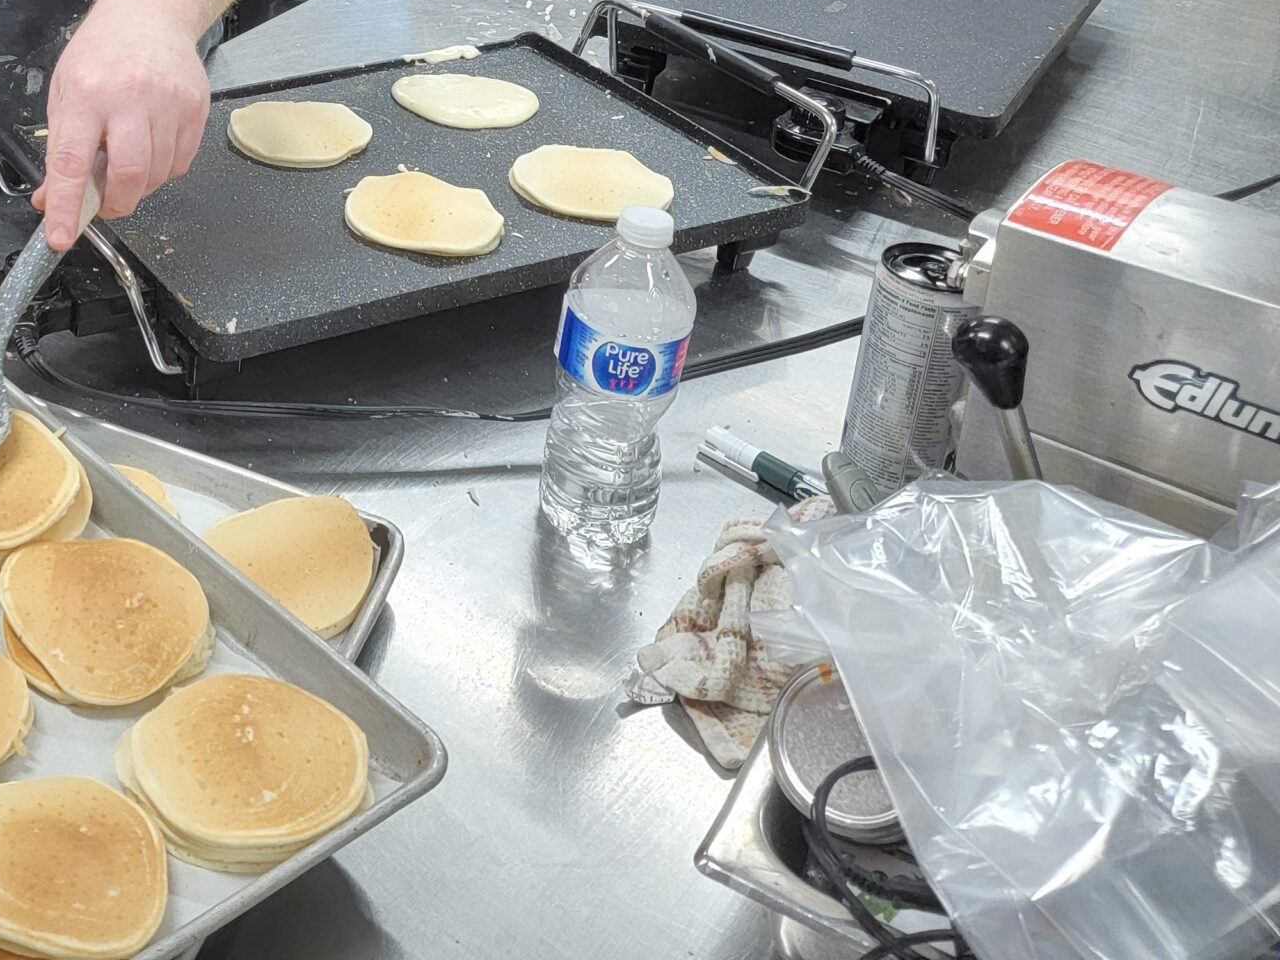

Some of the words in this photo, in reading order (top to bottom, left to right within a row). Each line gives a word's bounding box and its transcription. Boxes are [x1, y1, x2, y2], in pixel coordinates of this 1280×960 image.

[605, 343, 649, 365] Pure
[608, 359, 640, 378] Life
[1131, 362, 1280, 440] Edlun
